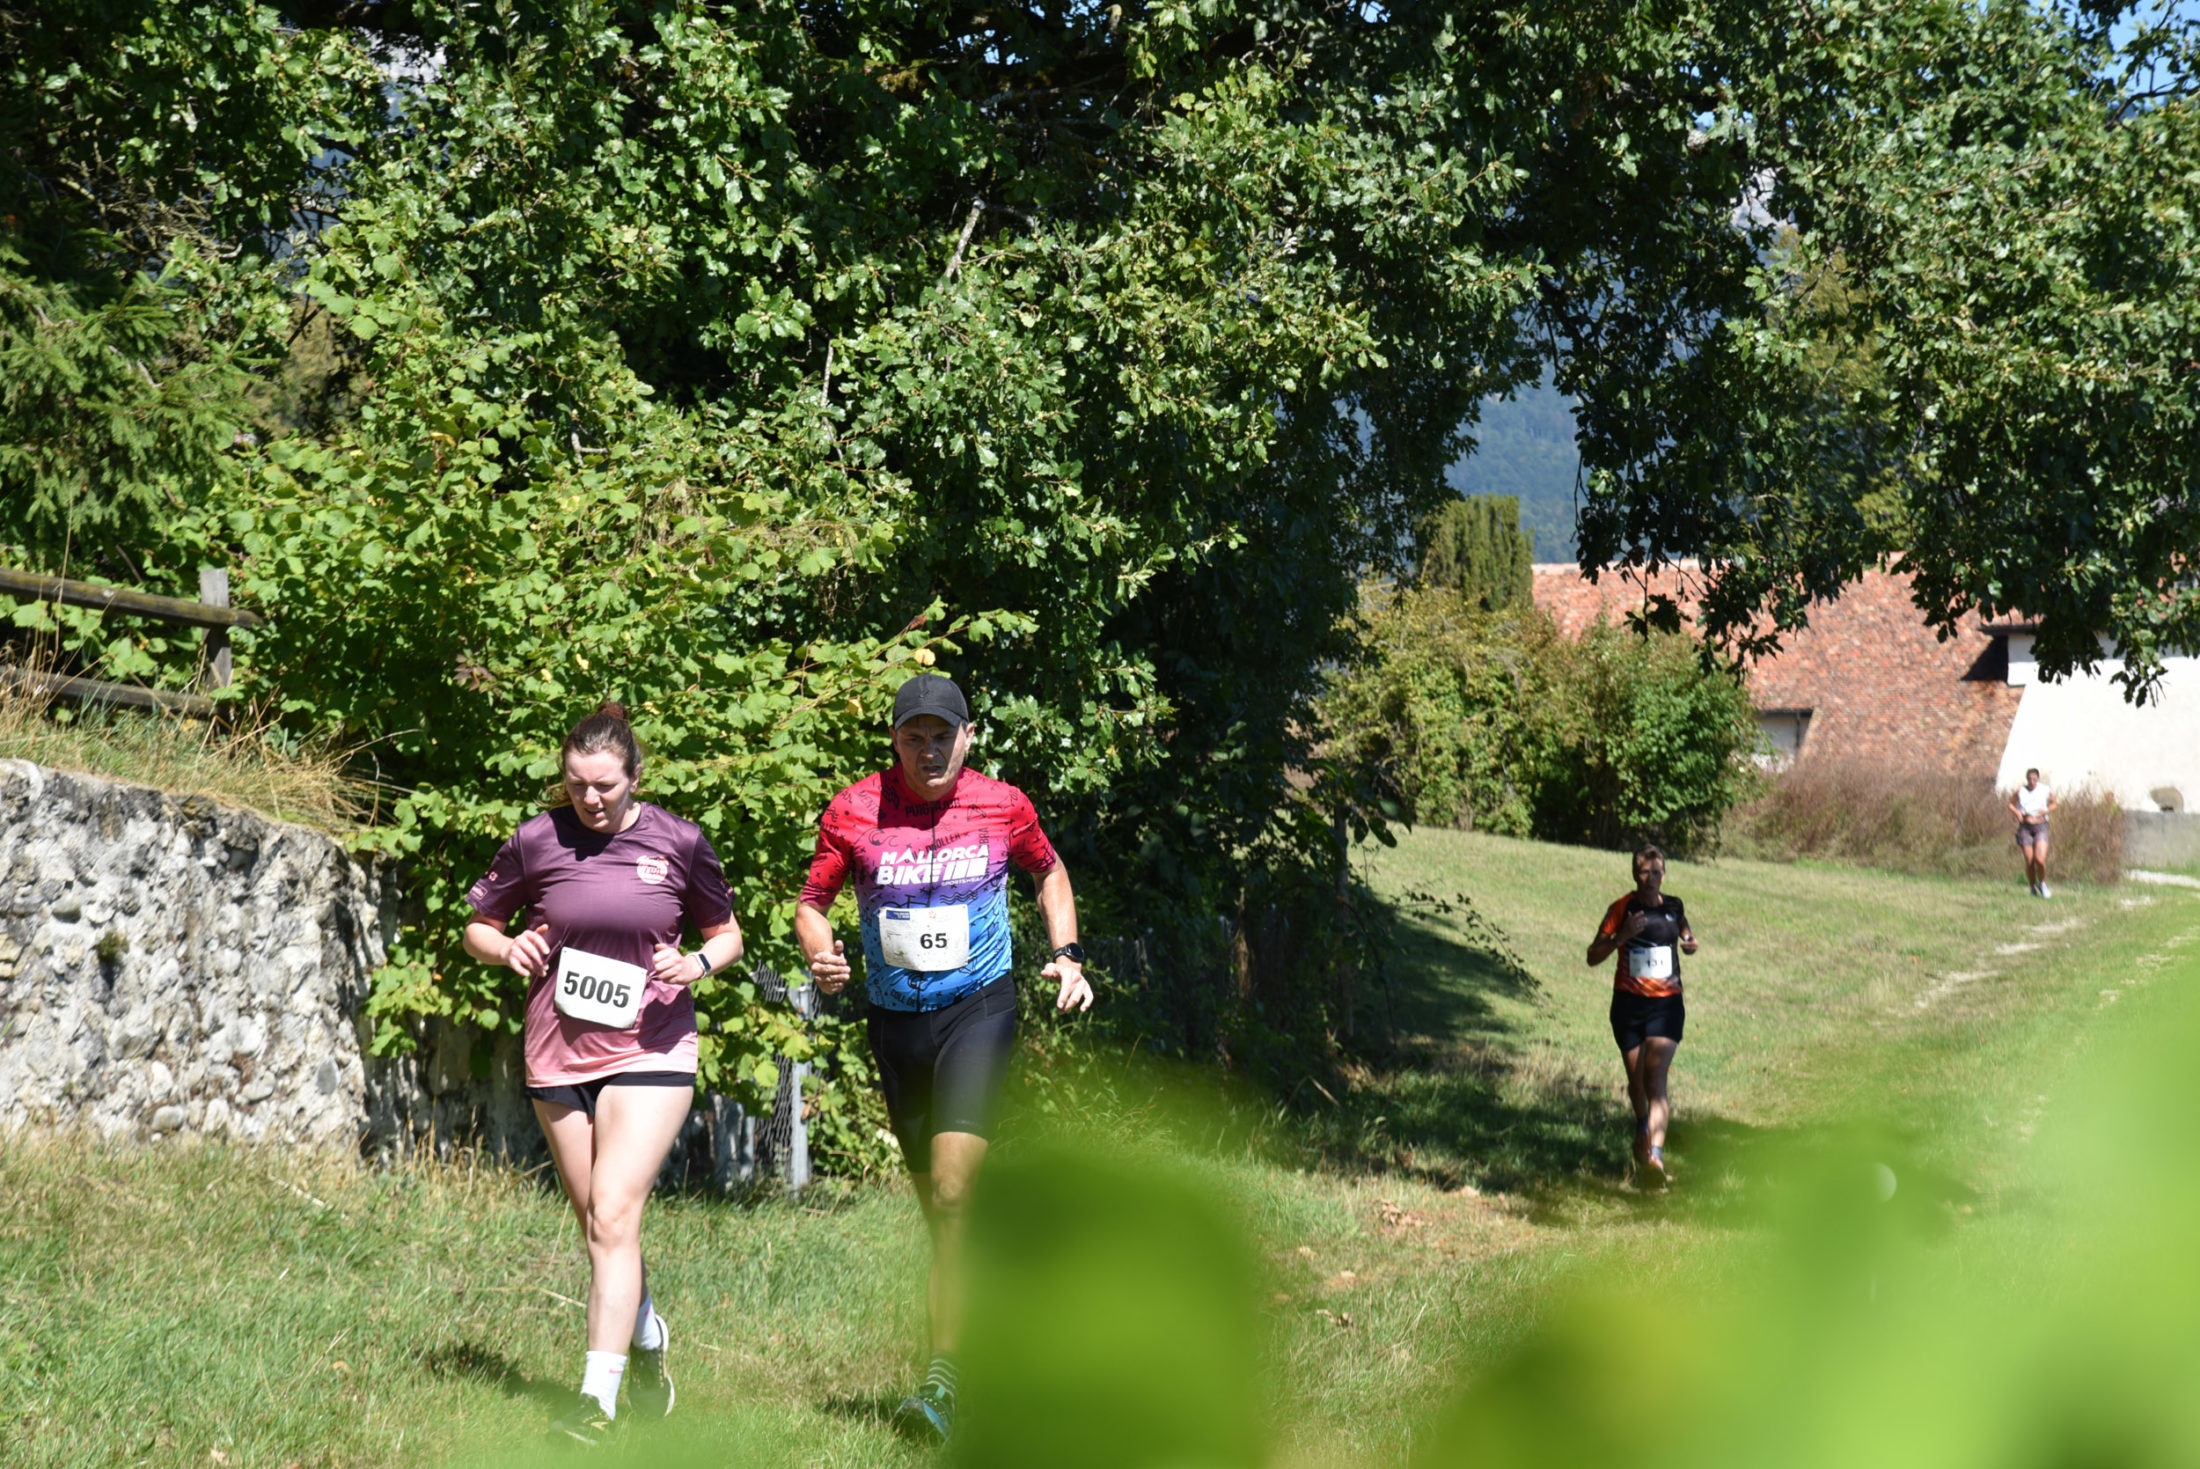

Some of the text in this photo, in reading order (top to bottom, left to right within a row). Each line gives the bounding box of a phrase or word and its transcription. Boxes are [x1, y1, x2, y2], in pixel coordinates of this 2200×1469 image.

[880, 844, 989, 865] MALLORCA
[876, 863, 944, 885] BIKE
[920, 933, 948, 949] 65
[563, 970, 631, 1008] 5005
